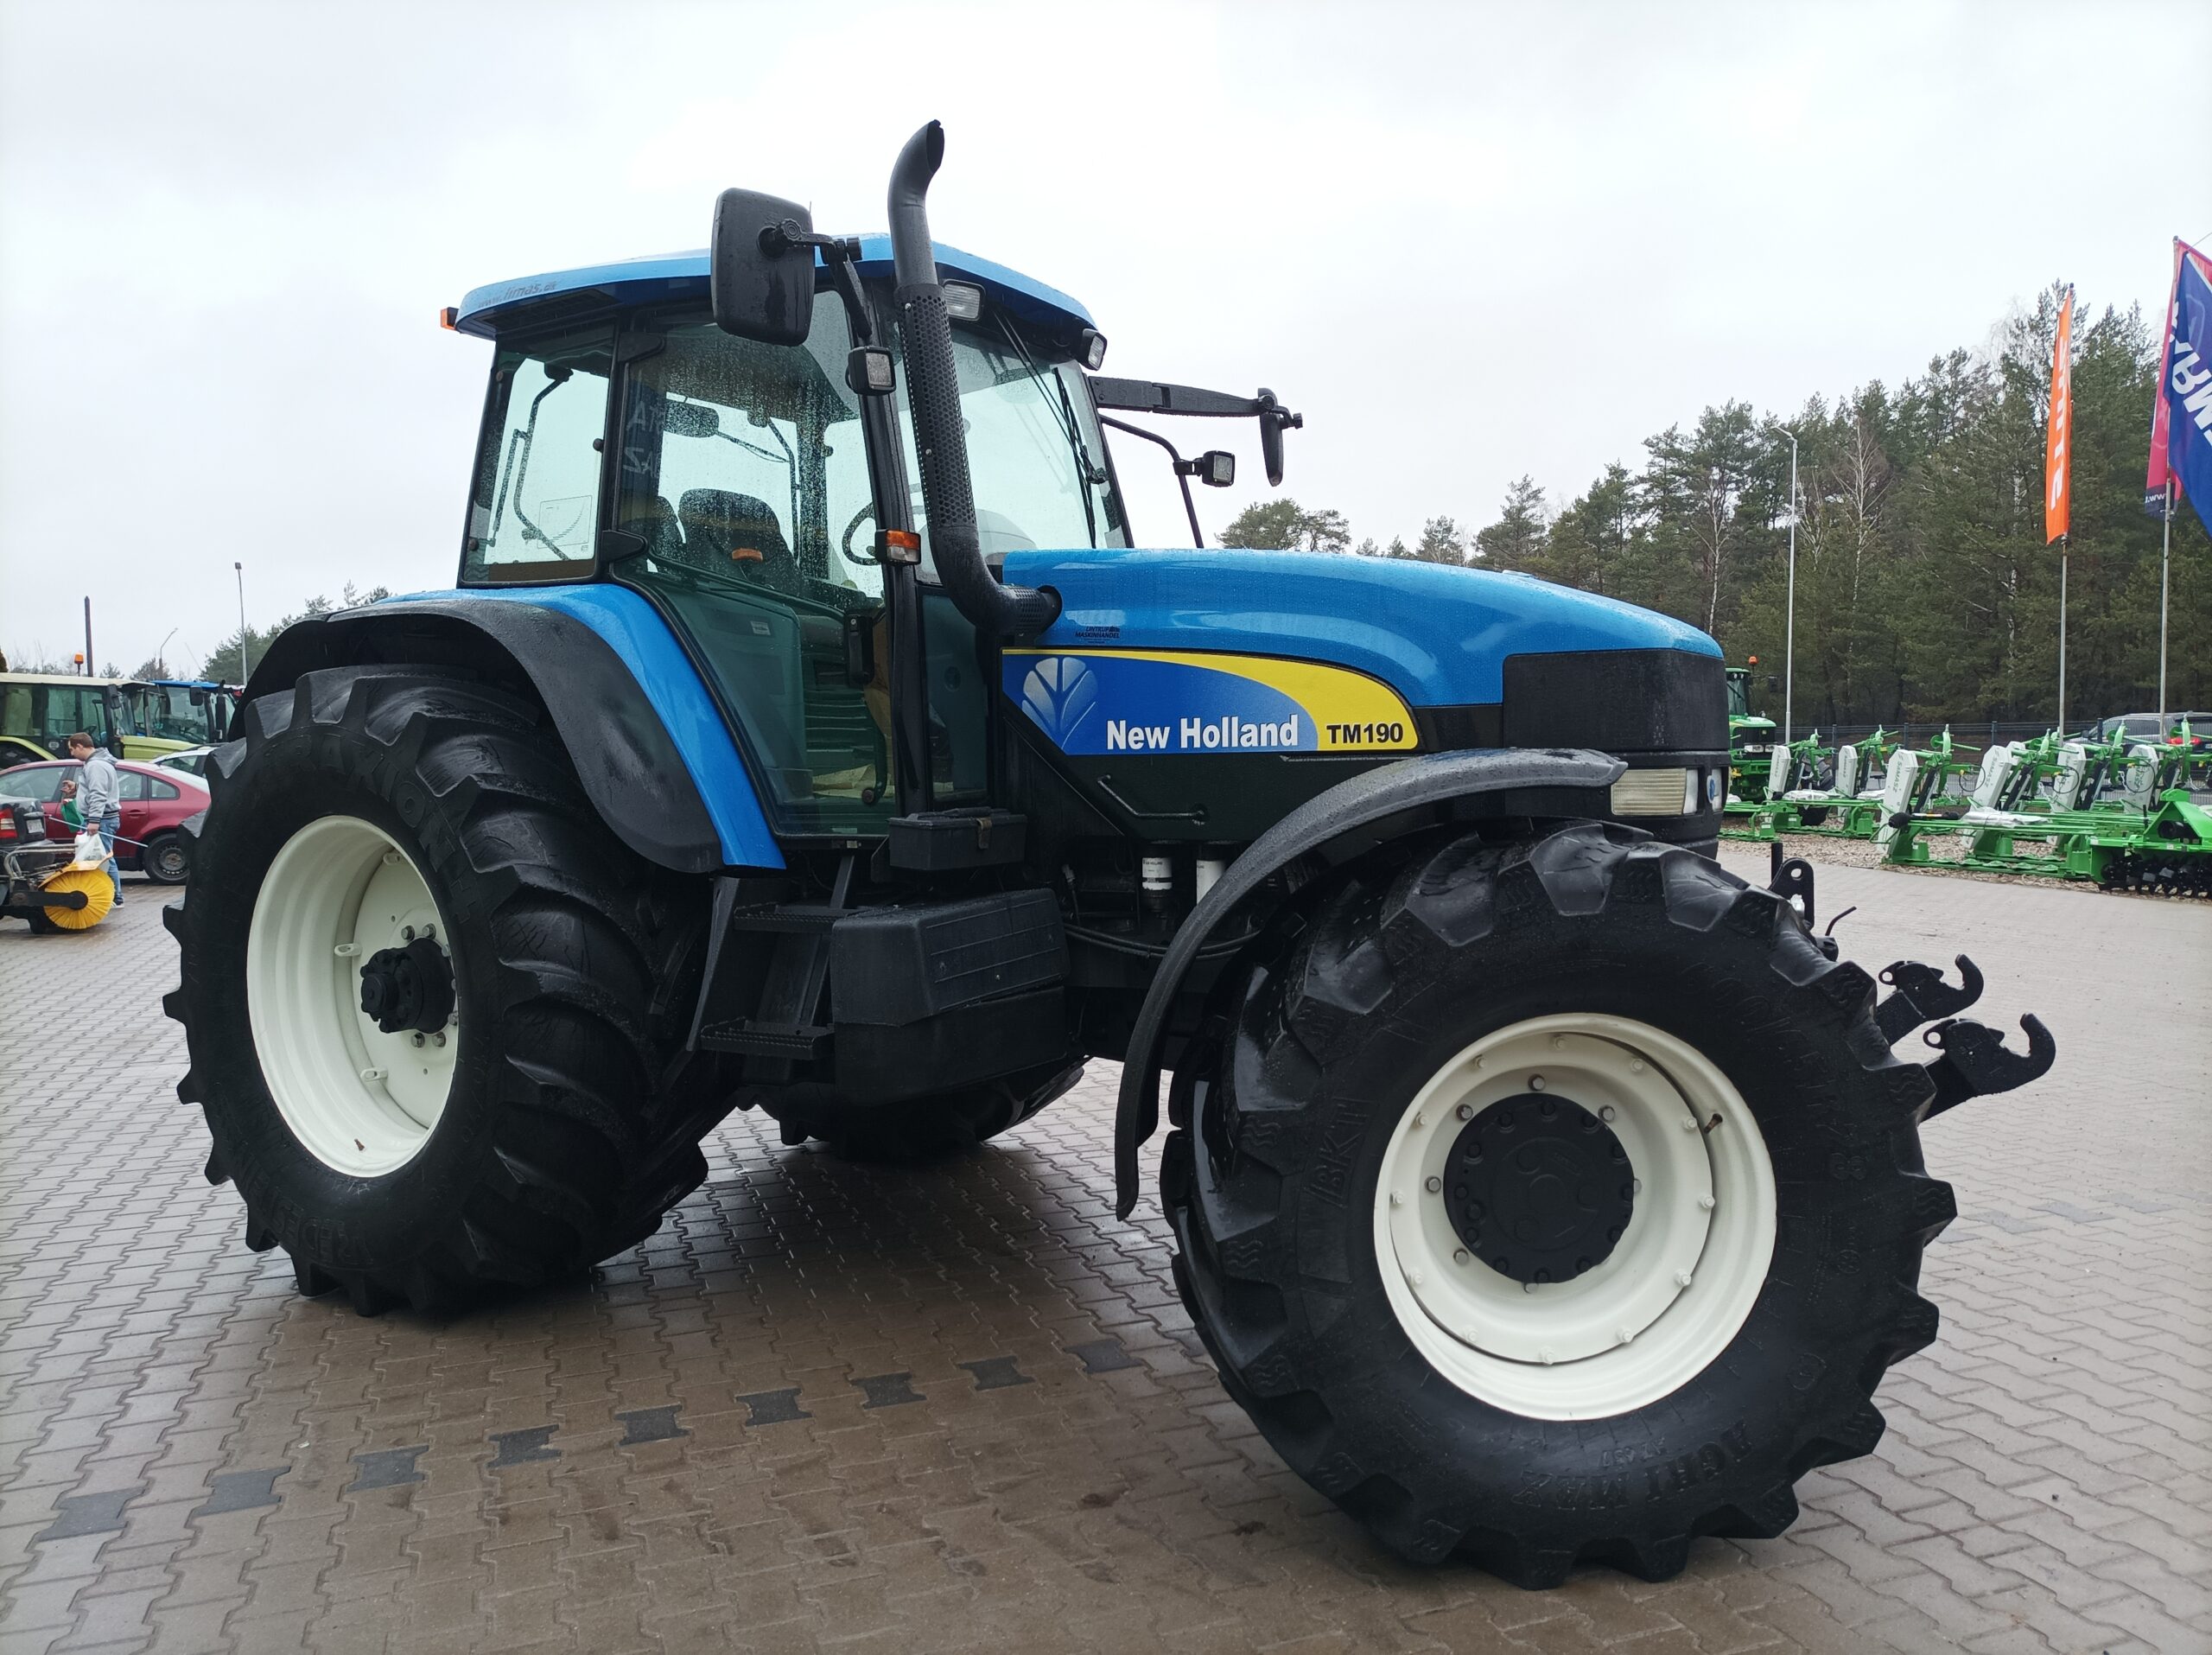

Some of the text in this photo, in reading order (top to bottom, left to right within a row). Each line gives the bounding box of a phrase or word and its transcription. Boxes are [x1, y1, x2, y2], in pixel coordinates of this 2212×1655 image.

[1107, 714, 1300, 750] New Holland
[1326, 723, 1404, 744] TM190
